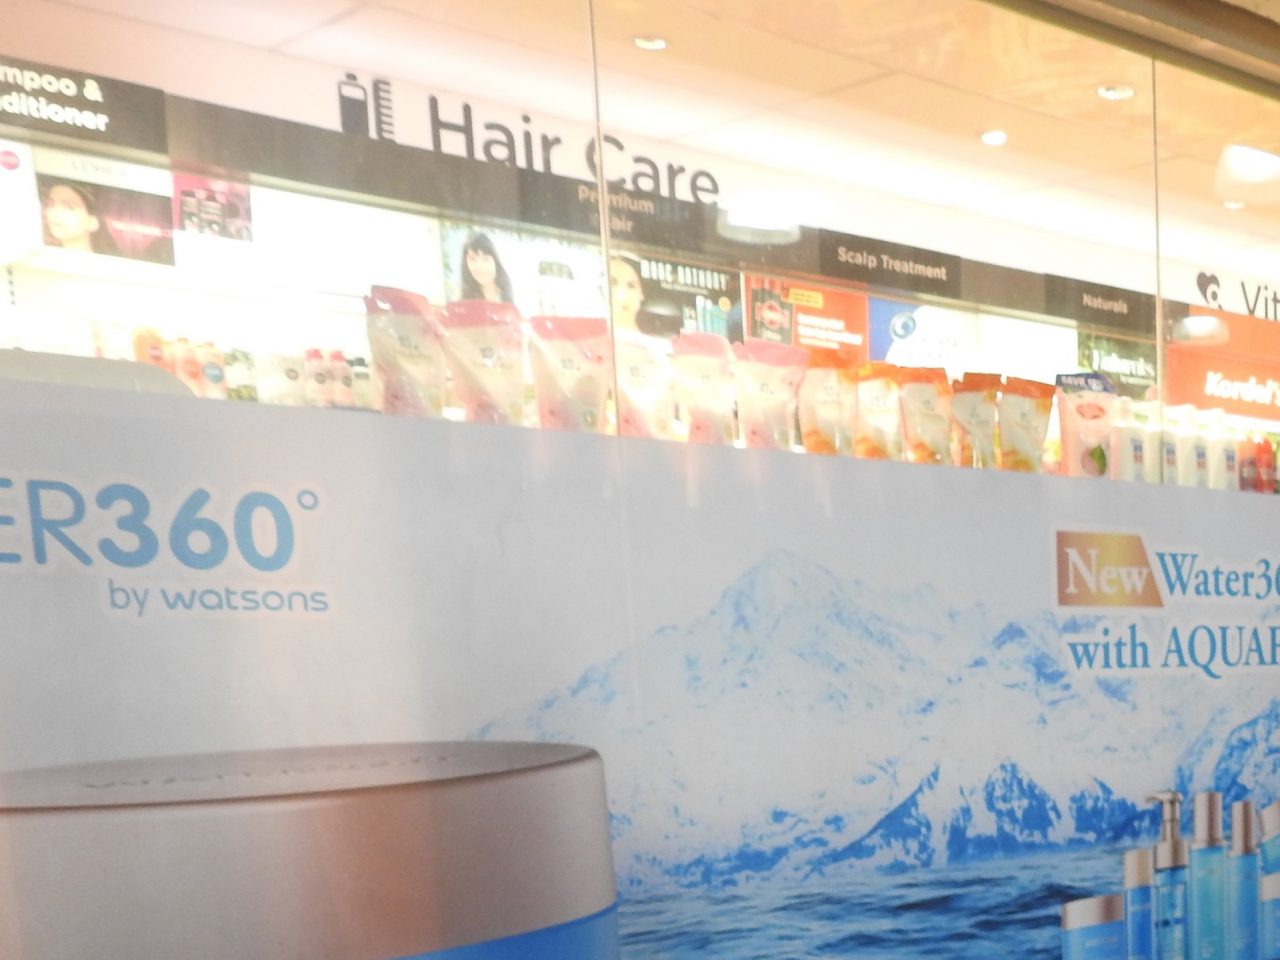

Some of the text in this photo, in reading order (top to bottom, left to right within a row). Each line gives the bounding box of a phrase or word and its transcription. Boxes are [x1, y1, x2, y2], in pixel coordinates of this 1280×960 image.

[0, 91, 110, 132] ditioner
[428, 94, 720, 204] Hair Care
[577, 184, 655, 215] Prmium
[837, 245, 947, 281] Scalp Treatment
[1081, 292, 1129, 315] Naturals
[1063, 546, 1156, 596] New
[107, 578, 330, 617] by watsons
[1067, 622, 1150, 671] with
